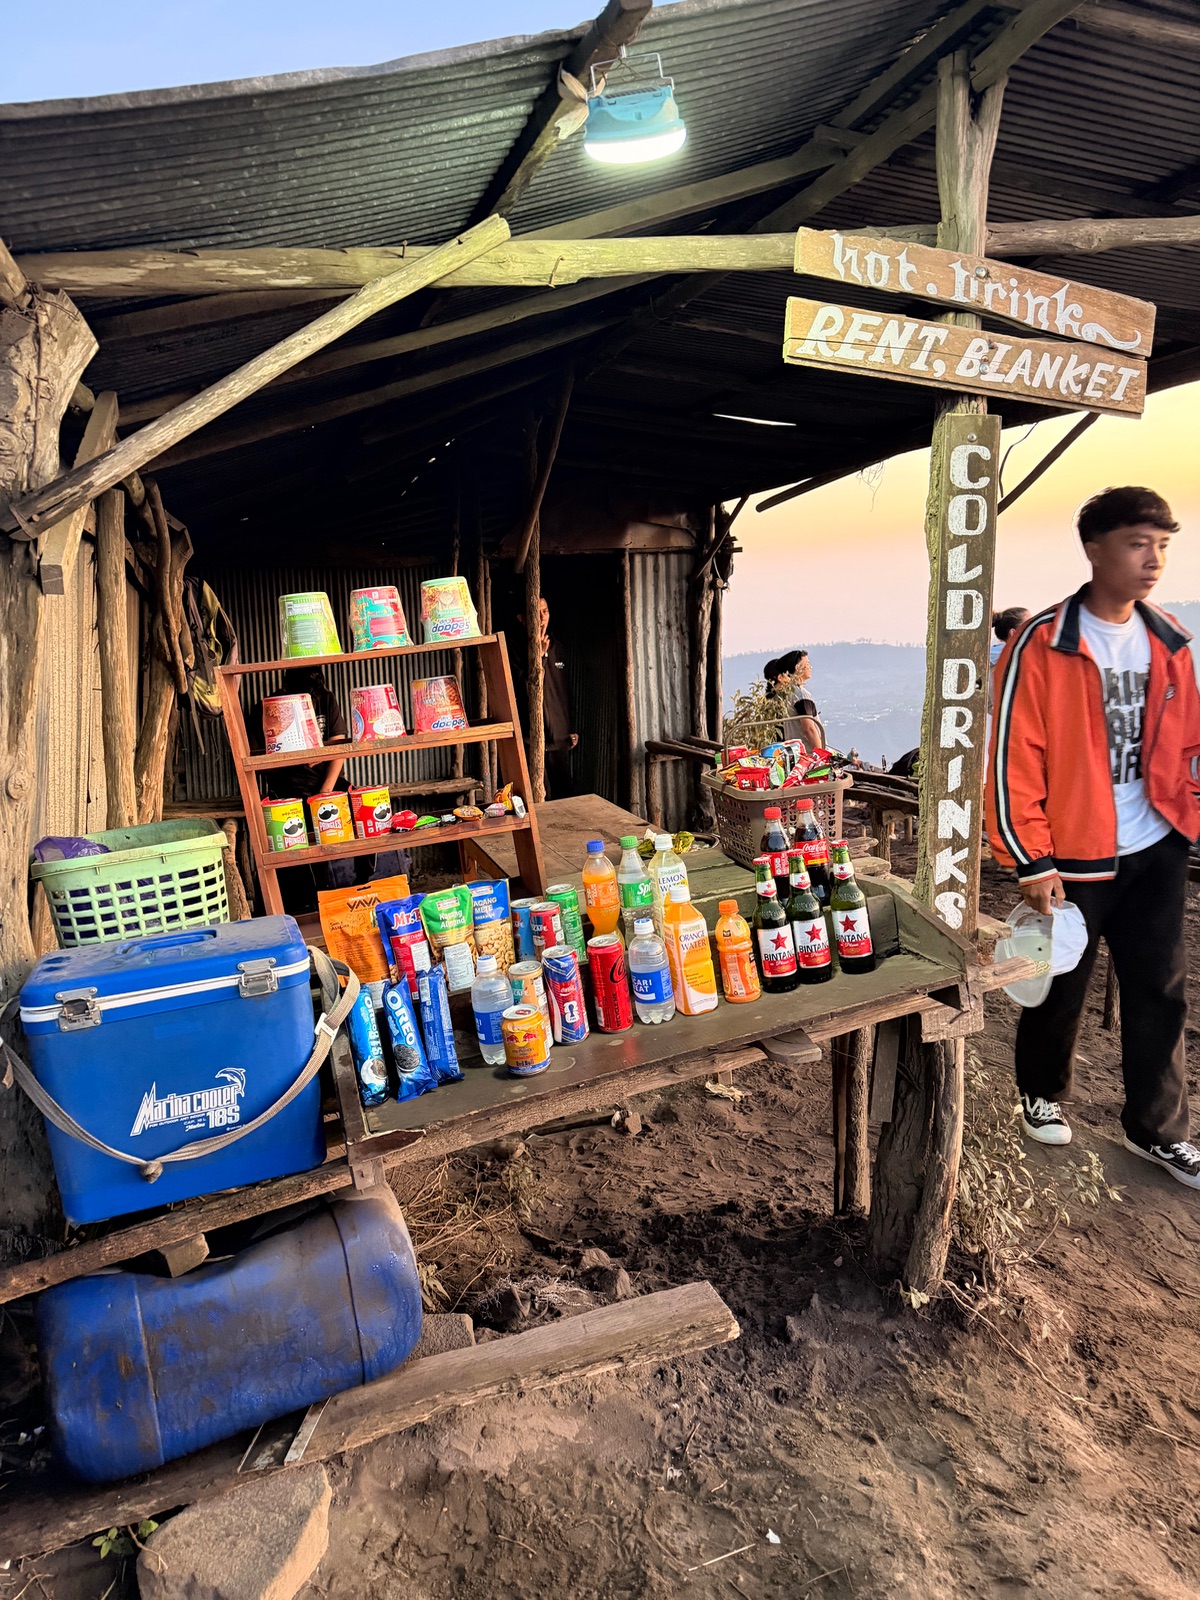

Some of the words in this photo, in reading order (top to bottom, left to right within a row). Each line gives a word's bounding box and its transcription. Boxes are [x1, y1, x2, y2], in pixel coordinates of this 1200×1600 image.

[955, 337, 1141, 401] BLANKET
[945, 444, 992, 630] COLD
[934, 658, 977, 930] DRINKS
[658, 873, 685, 885] LEMON
[474, 896, 498, 907] ACANG
[679, 929, 706, 943] ORANGE
[681, 939, 707, 951] WATER
[835, 931, 868, 943] BINTANG
[386, 990, 416, 1046] OREO
[130, 1081, 192, 1137] Marina
[193, 1084, 240, 1113] cooler
[206, 1105, 240, 1129] 18S
